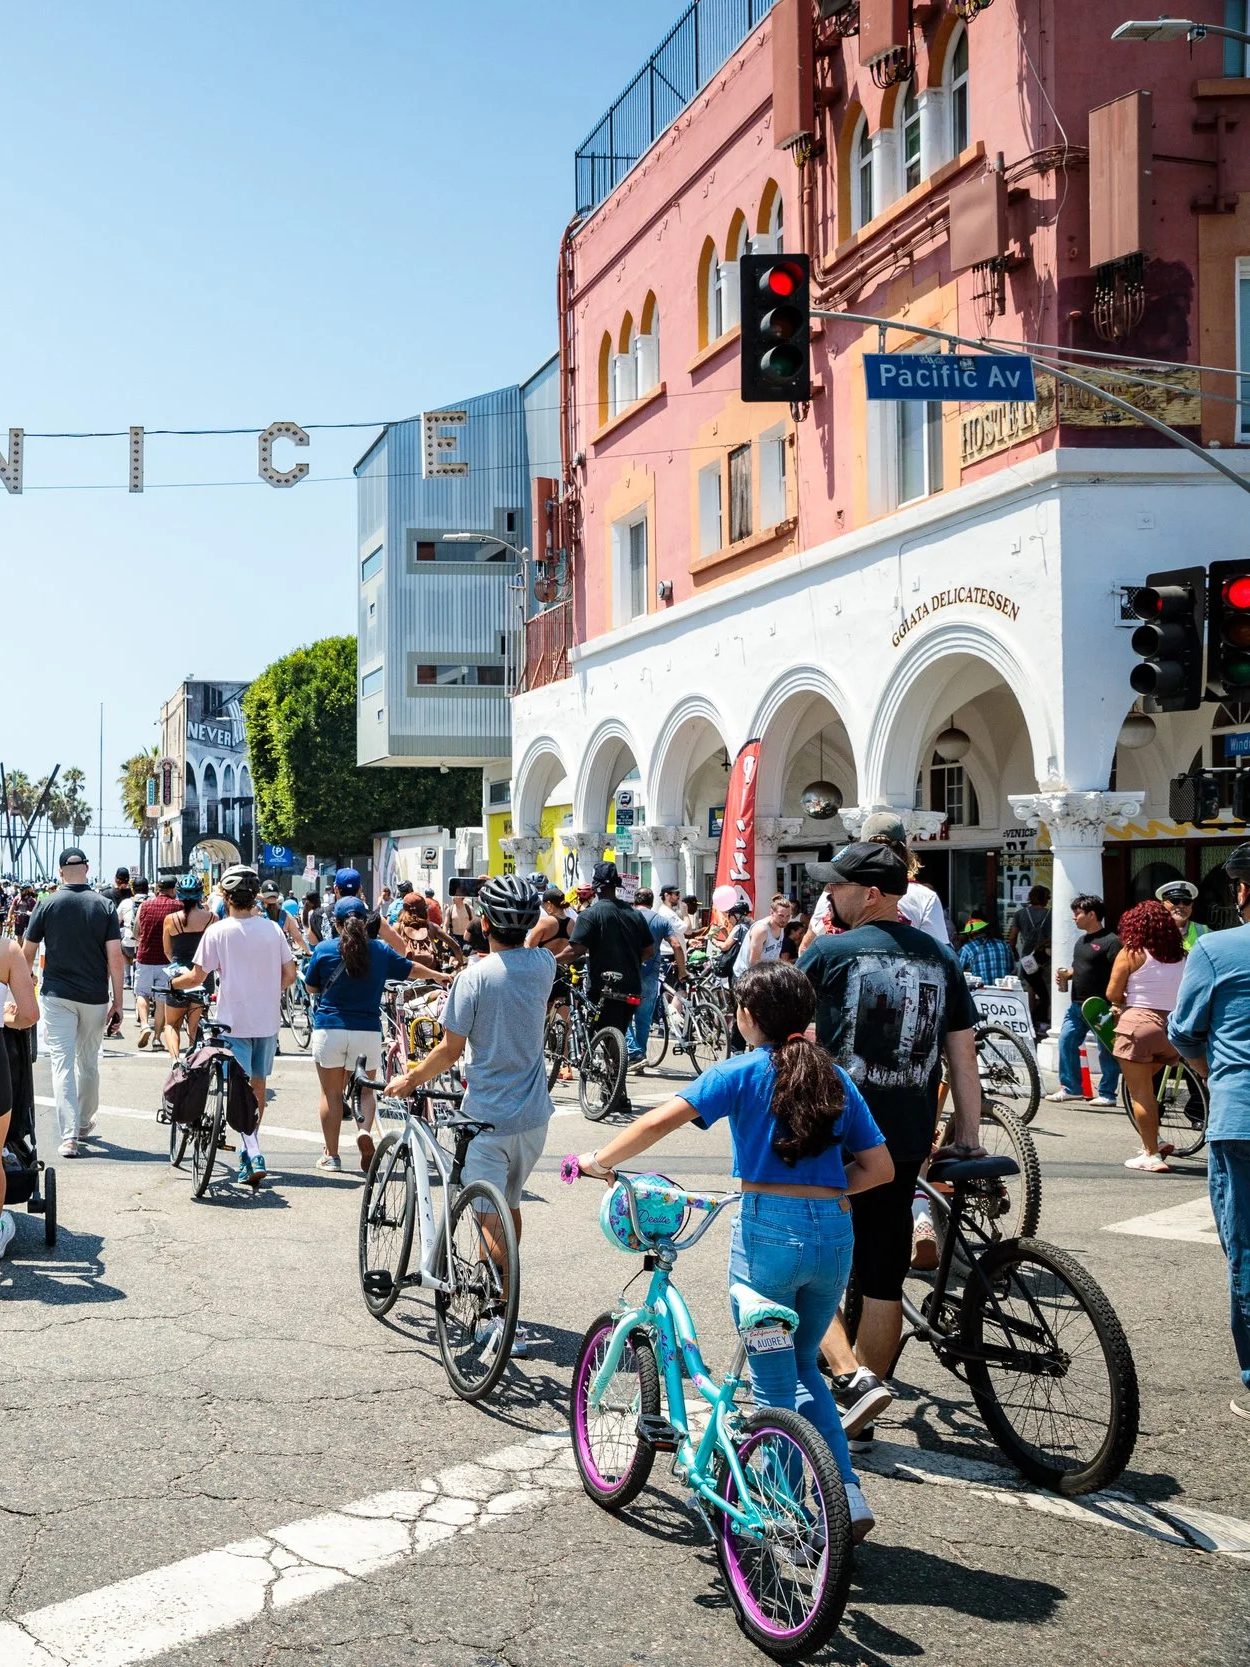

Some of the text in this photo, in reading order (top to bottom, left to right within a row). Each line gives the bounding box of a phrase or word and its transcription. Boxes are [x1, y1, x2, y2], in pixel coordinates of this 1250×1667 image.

[879, 364, 1021, 388] Pacific Av
[961, 400, 1033, 458] HOSTEL
[891, 586, 1021, 648] GGIATA DELICATESSEN
[187, 720, 232, 747] NEVER
[1004, 827, 1036, 839] VENICE
[980, 1003, 1017, 1017] ROAD
[757, 1336, 787, 1348] AUDREY
